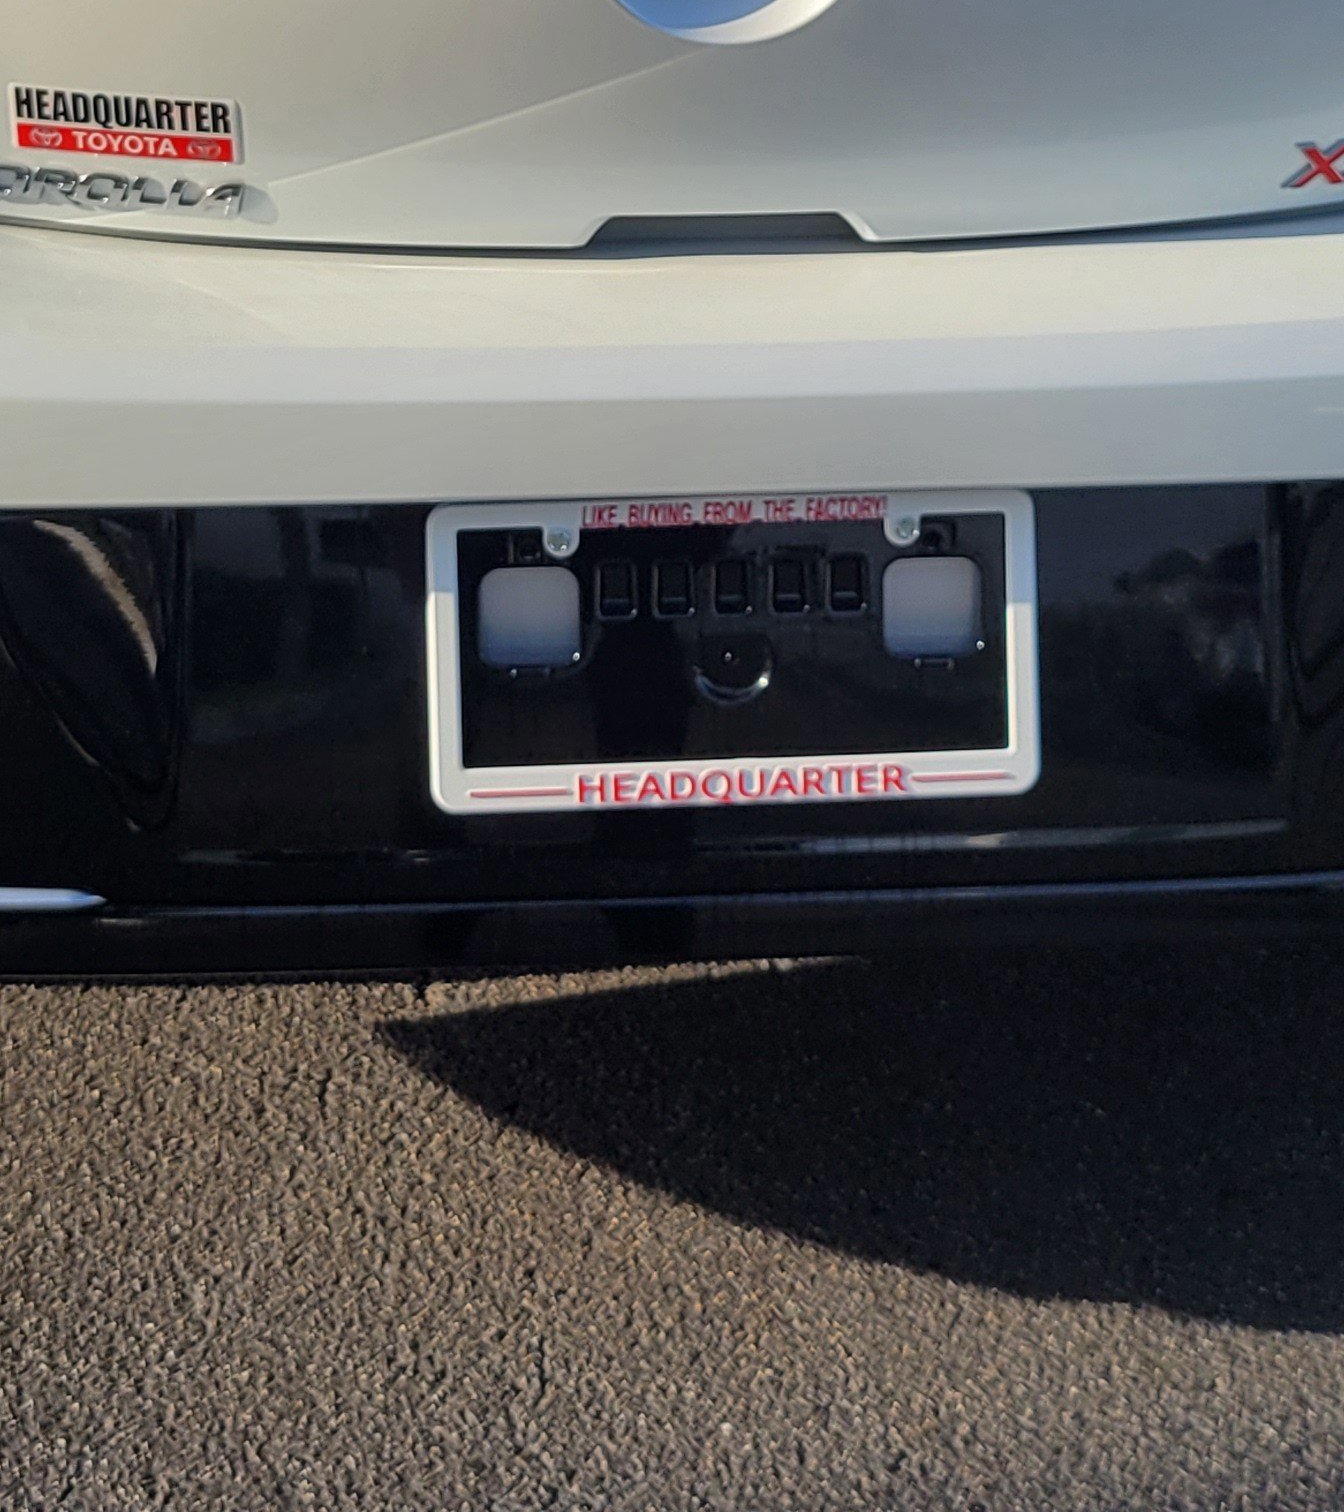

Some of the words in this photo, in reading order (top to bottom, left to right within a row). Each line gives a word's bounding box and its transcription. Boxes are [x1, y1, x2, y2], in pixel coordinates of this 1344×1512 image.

[14, 86, 233, 134] HEADQUARTER
[72, 130, 178, 157] TOYOTA
[582, 504, 618, 528] LIKE
[628, 502, 692, 526] BUYING
[704, 500, 752, 524] FROM
[763, 499, 795, 522] THE
[578, 763, 908, 804] HEADQUARTER
